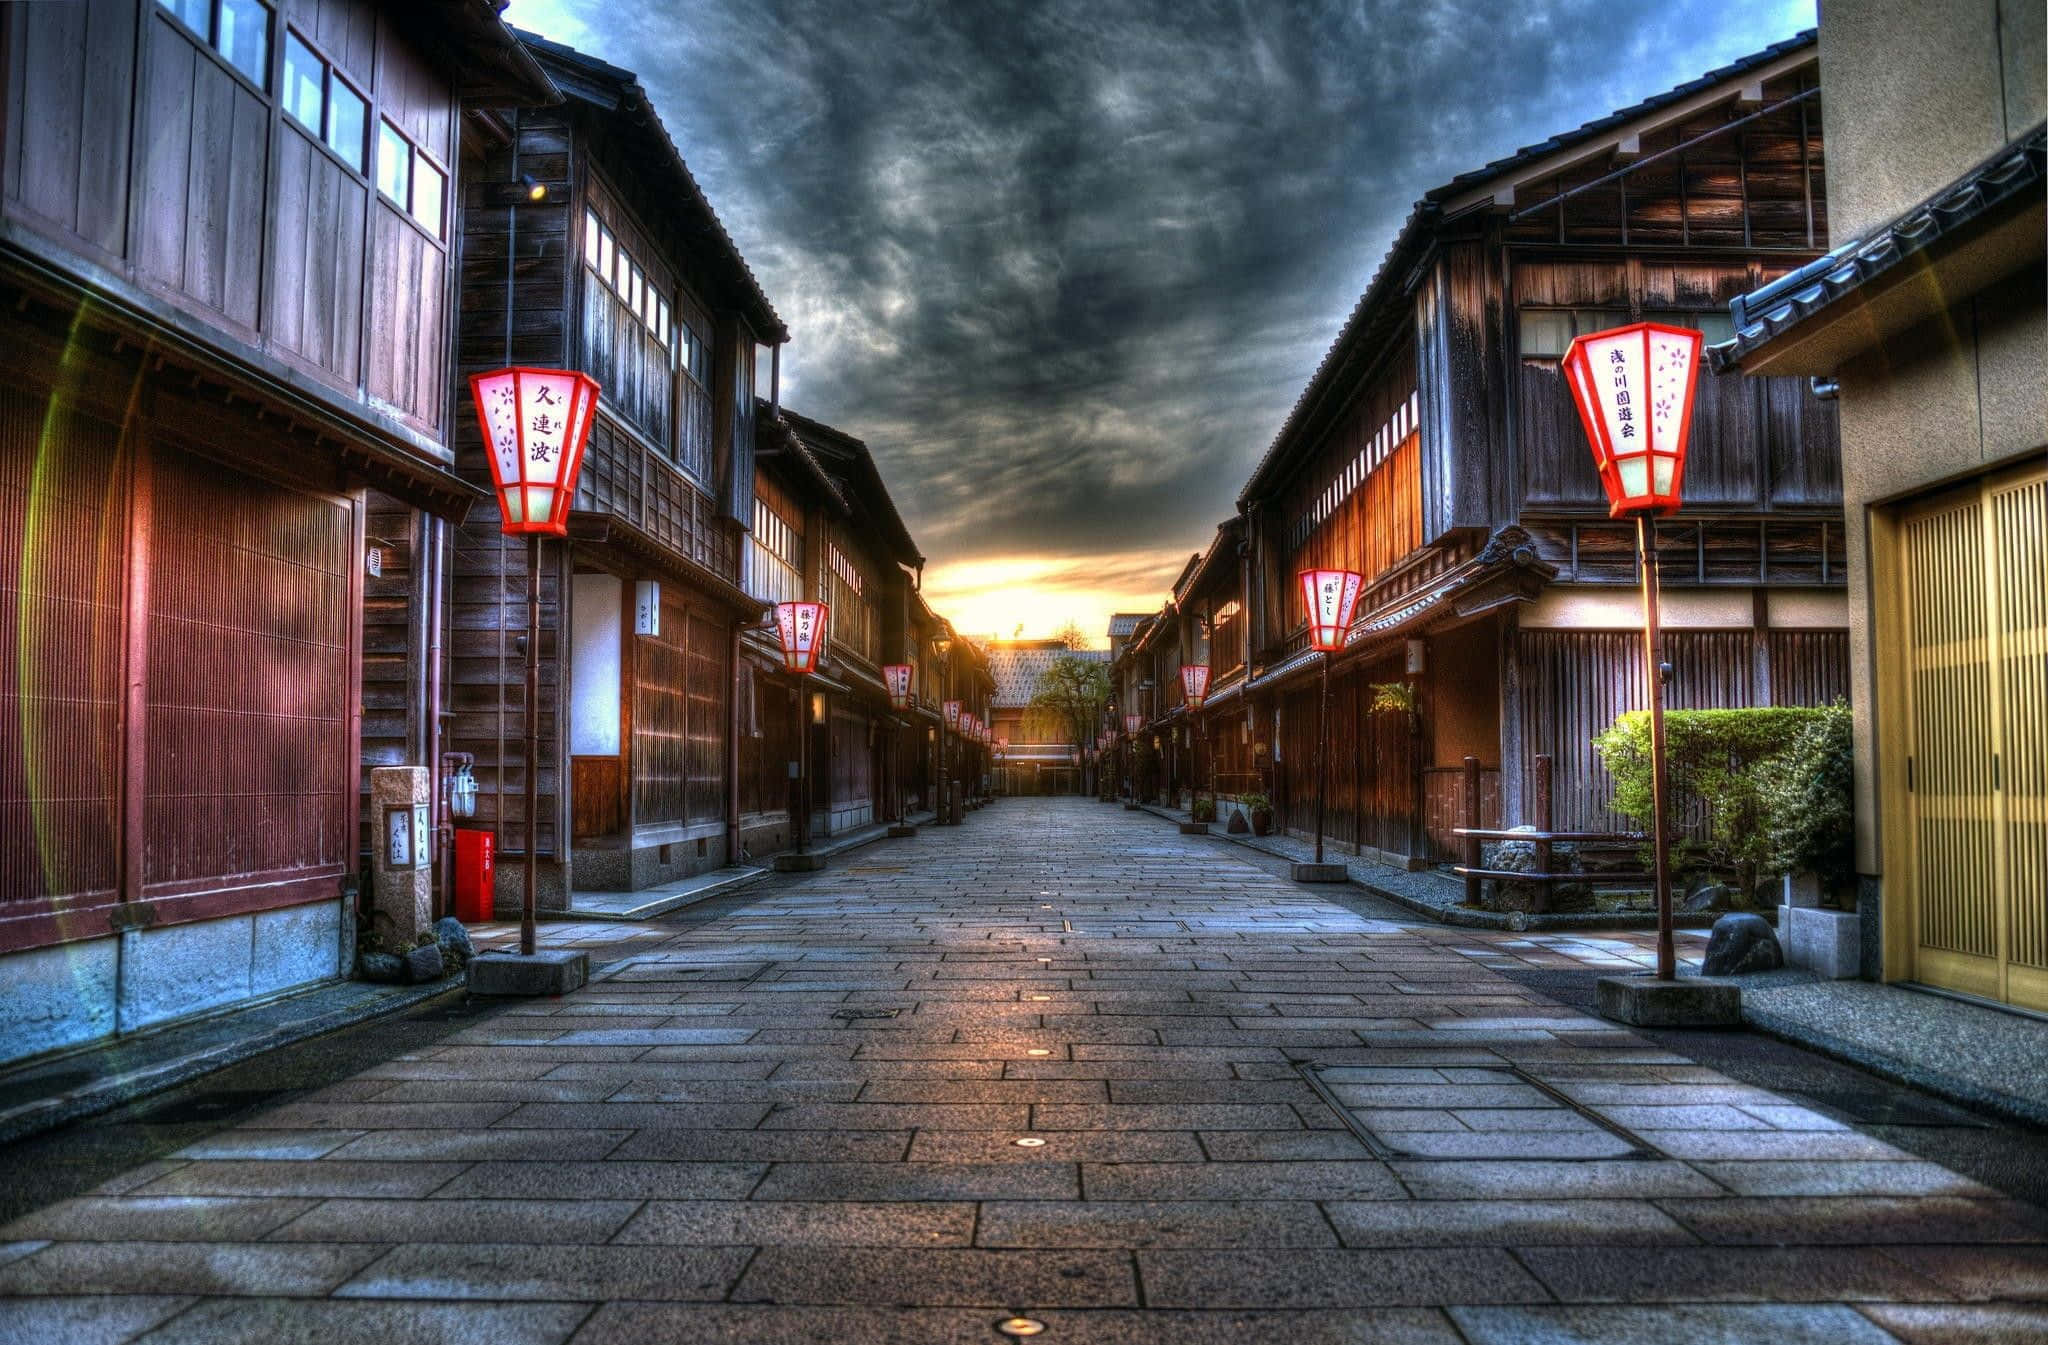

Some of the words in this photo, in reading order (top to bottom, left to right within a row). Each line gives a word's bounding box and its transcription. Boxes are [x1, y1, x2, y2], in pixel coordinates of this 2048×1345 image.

[531, 385, 555, 463] 久連波
[1610, 349, 1635, 438] 浅の川園遊会
